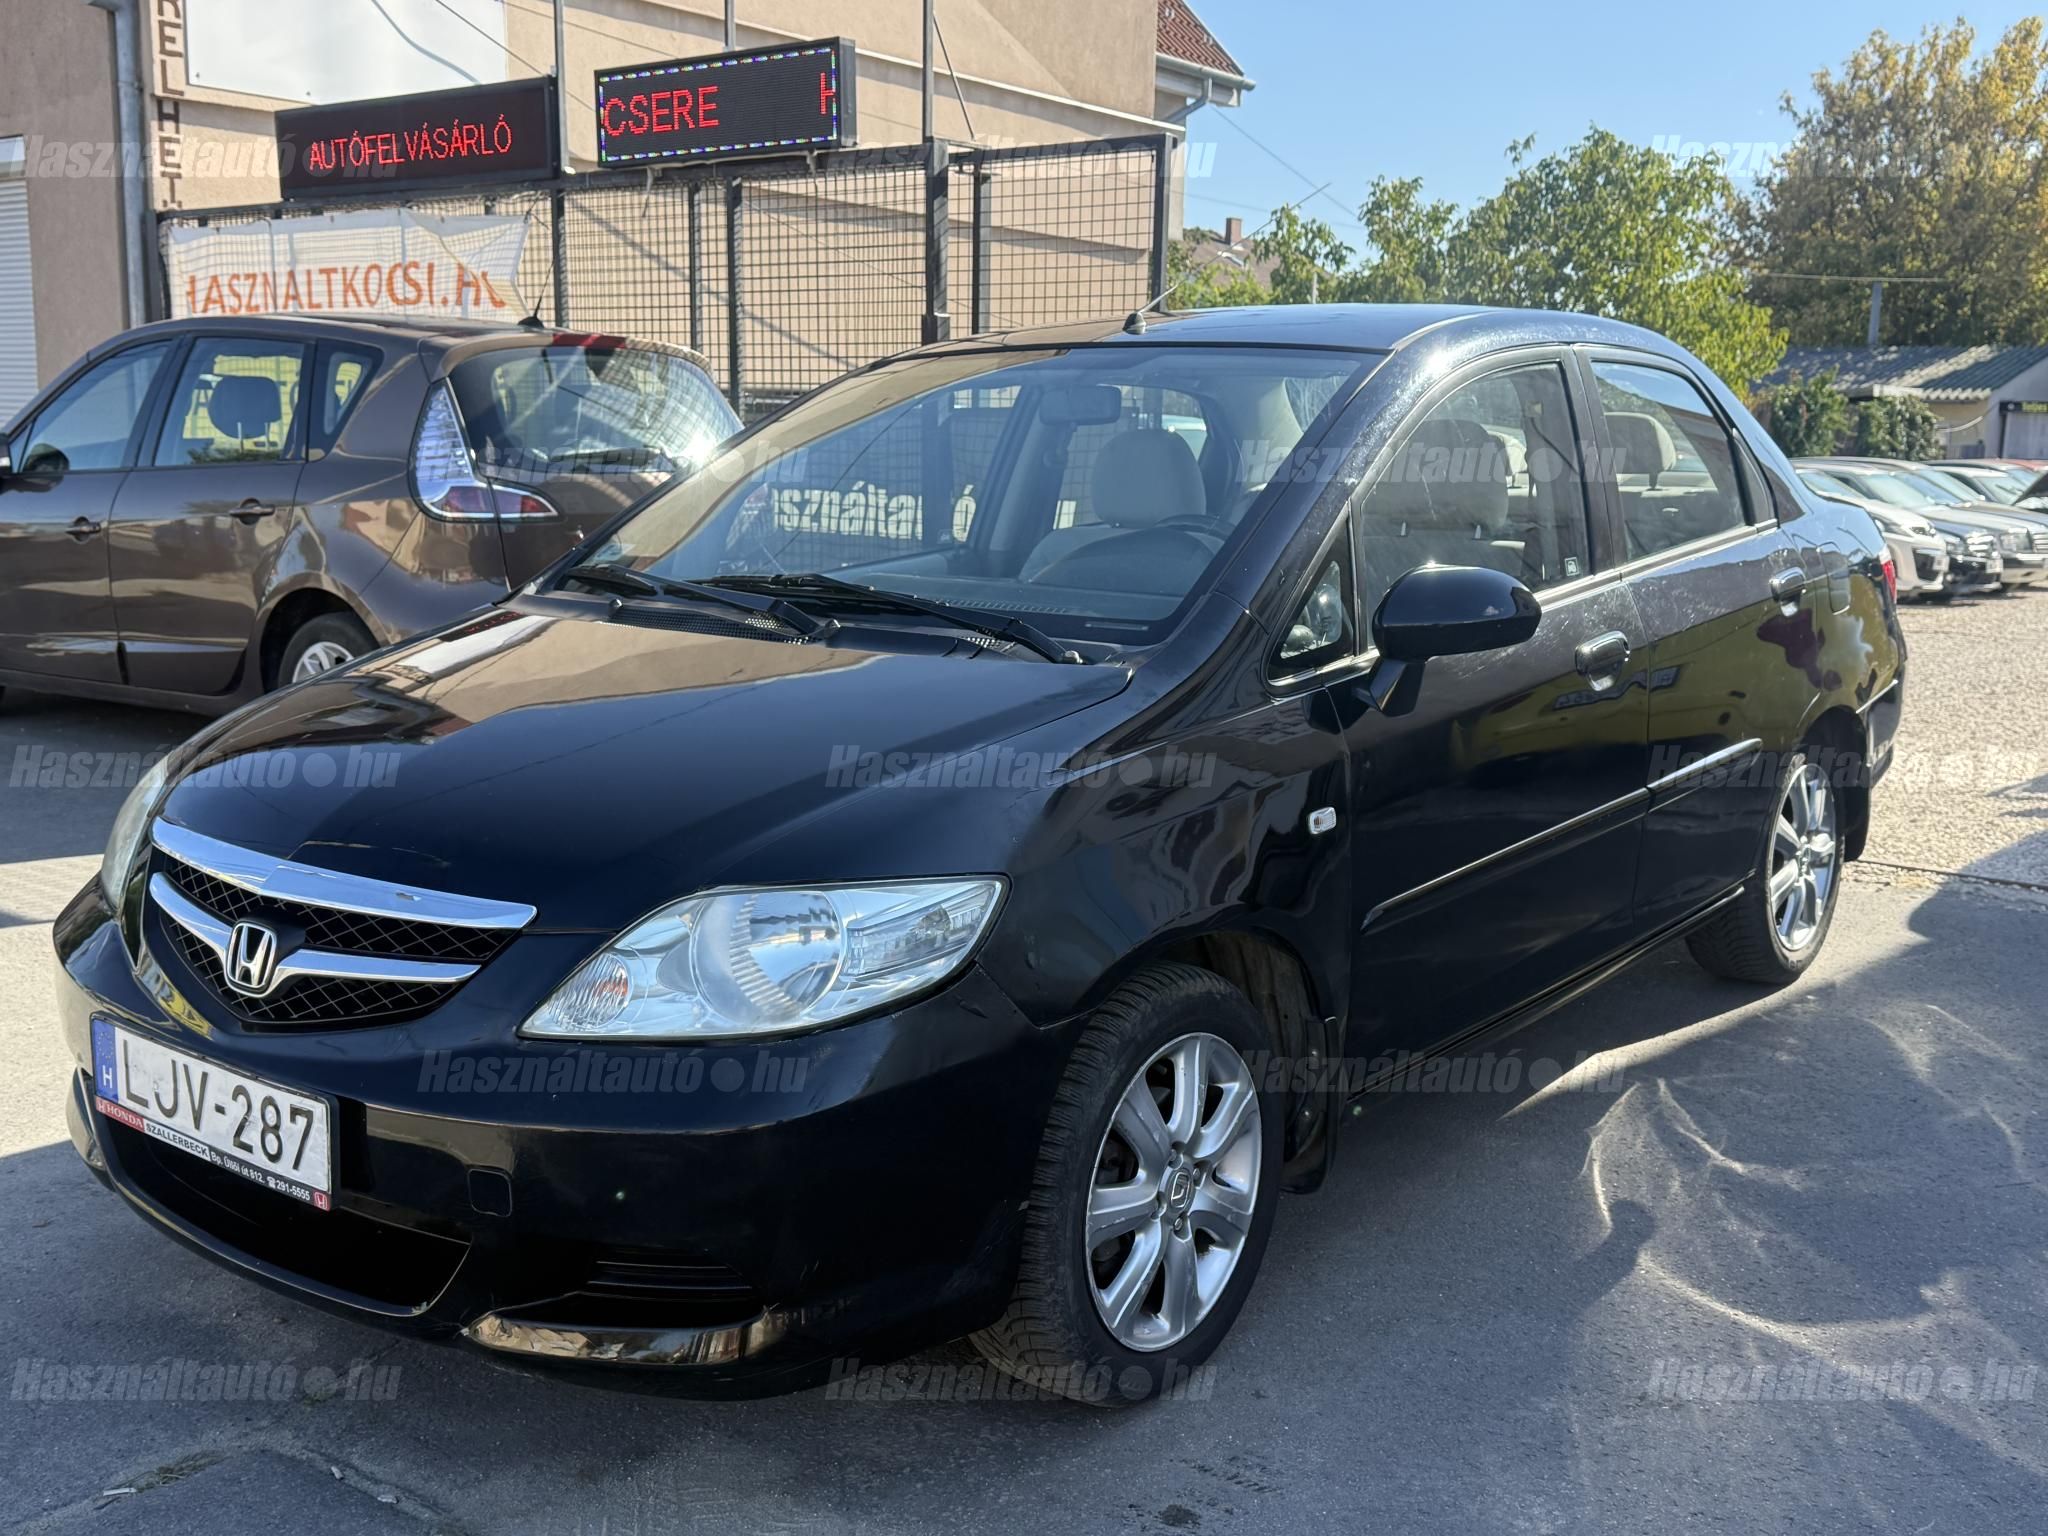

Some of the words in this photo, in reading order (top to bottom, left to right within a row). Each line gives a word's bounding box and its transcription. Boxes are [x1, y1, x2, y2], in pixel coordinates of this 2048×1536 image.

[603, 85, 720, 136] CSERE
[309, 114, 512, 170] AUTÓFELVÁSÁRLÓ
[102, 1065, 113, 1089] H
[122, 1038, 315, 1171] LJV-287
[106, 1103, 144, 1129] HONDA
[146, 1123, 209, 1158] SZALLERBECK
[276, 1179, 311, 1201] 291-5555
